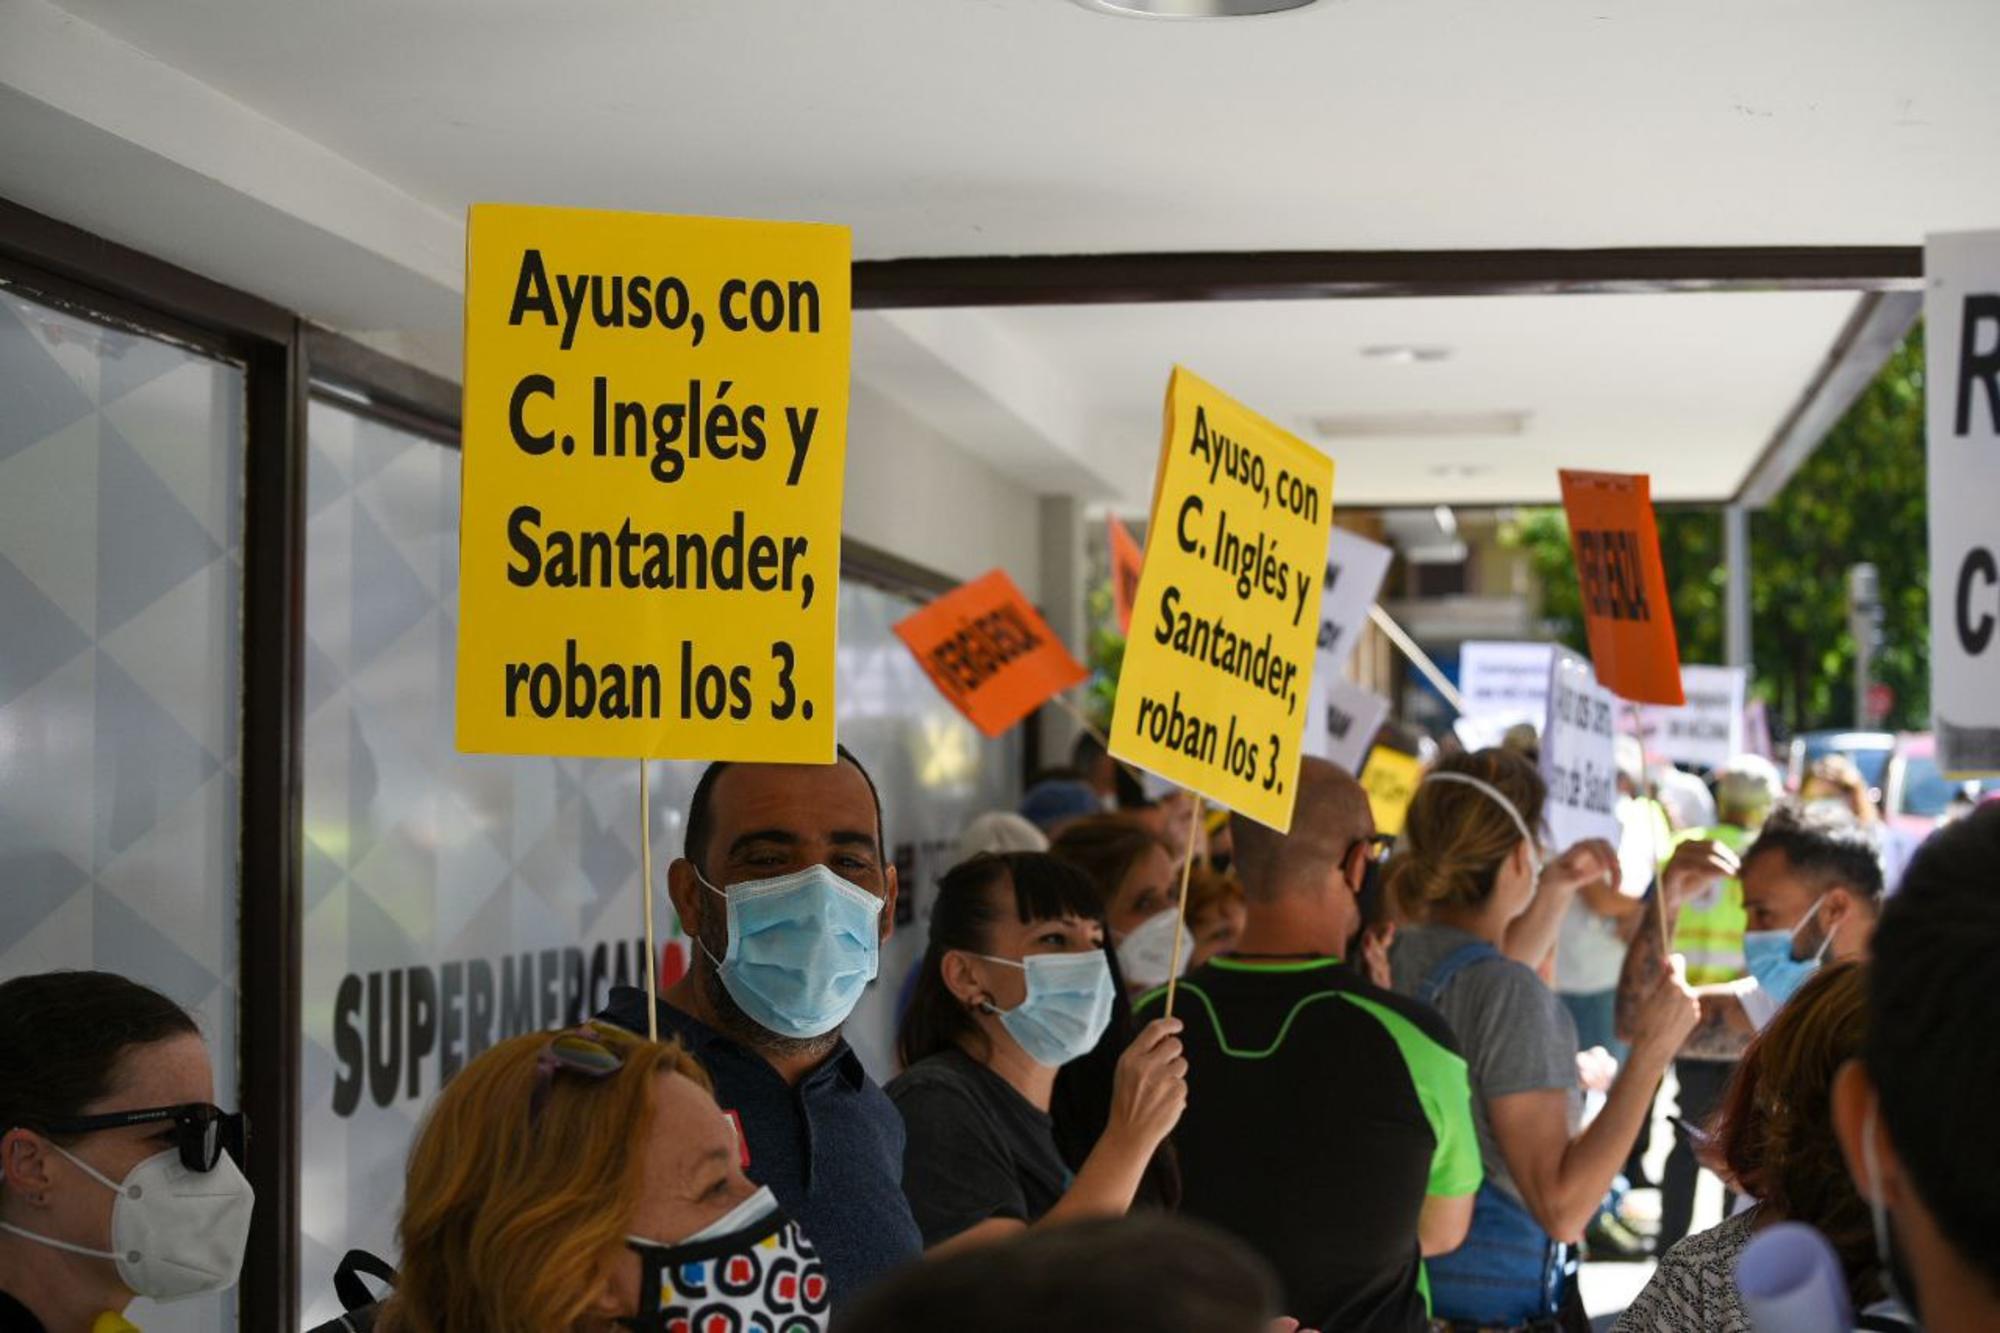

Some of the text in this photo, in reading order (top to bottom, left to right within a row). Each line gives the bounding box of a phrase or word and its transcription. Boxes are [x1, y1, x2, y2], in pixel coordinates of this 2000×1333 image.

[509, 249, 820, 351] Ayuso, con
[508, 373, 819, 486] C. Inglés y
[1190, 406, 1319, 525] Ayuso, con
[507, 505, 815, 609] Santander,
[1177, 495, 1206, 559] C.
[1215, 512, 1290, 604] Inglés
[1294, 573, 1311, 626] y
[1955, 546, 2000, 656] C
[506, 639, 814, 721] roban los 3.
[1154, 586, 1299, 715] Santander,
[1136, 691, 1217, 764] roban
[1224, 715, 1260, 783] los
[1264, 734, 1287, 794] 3.
